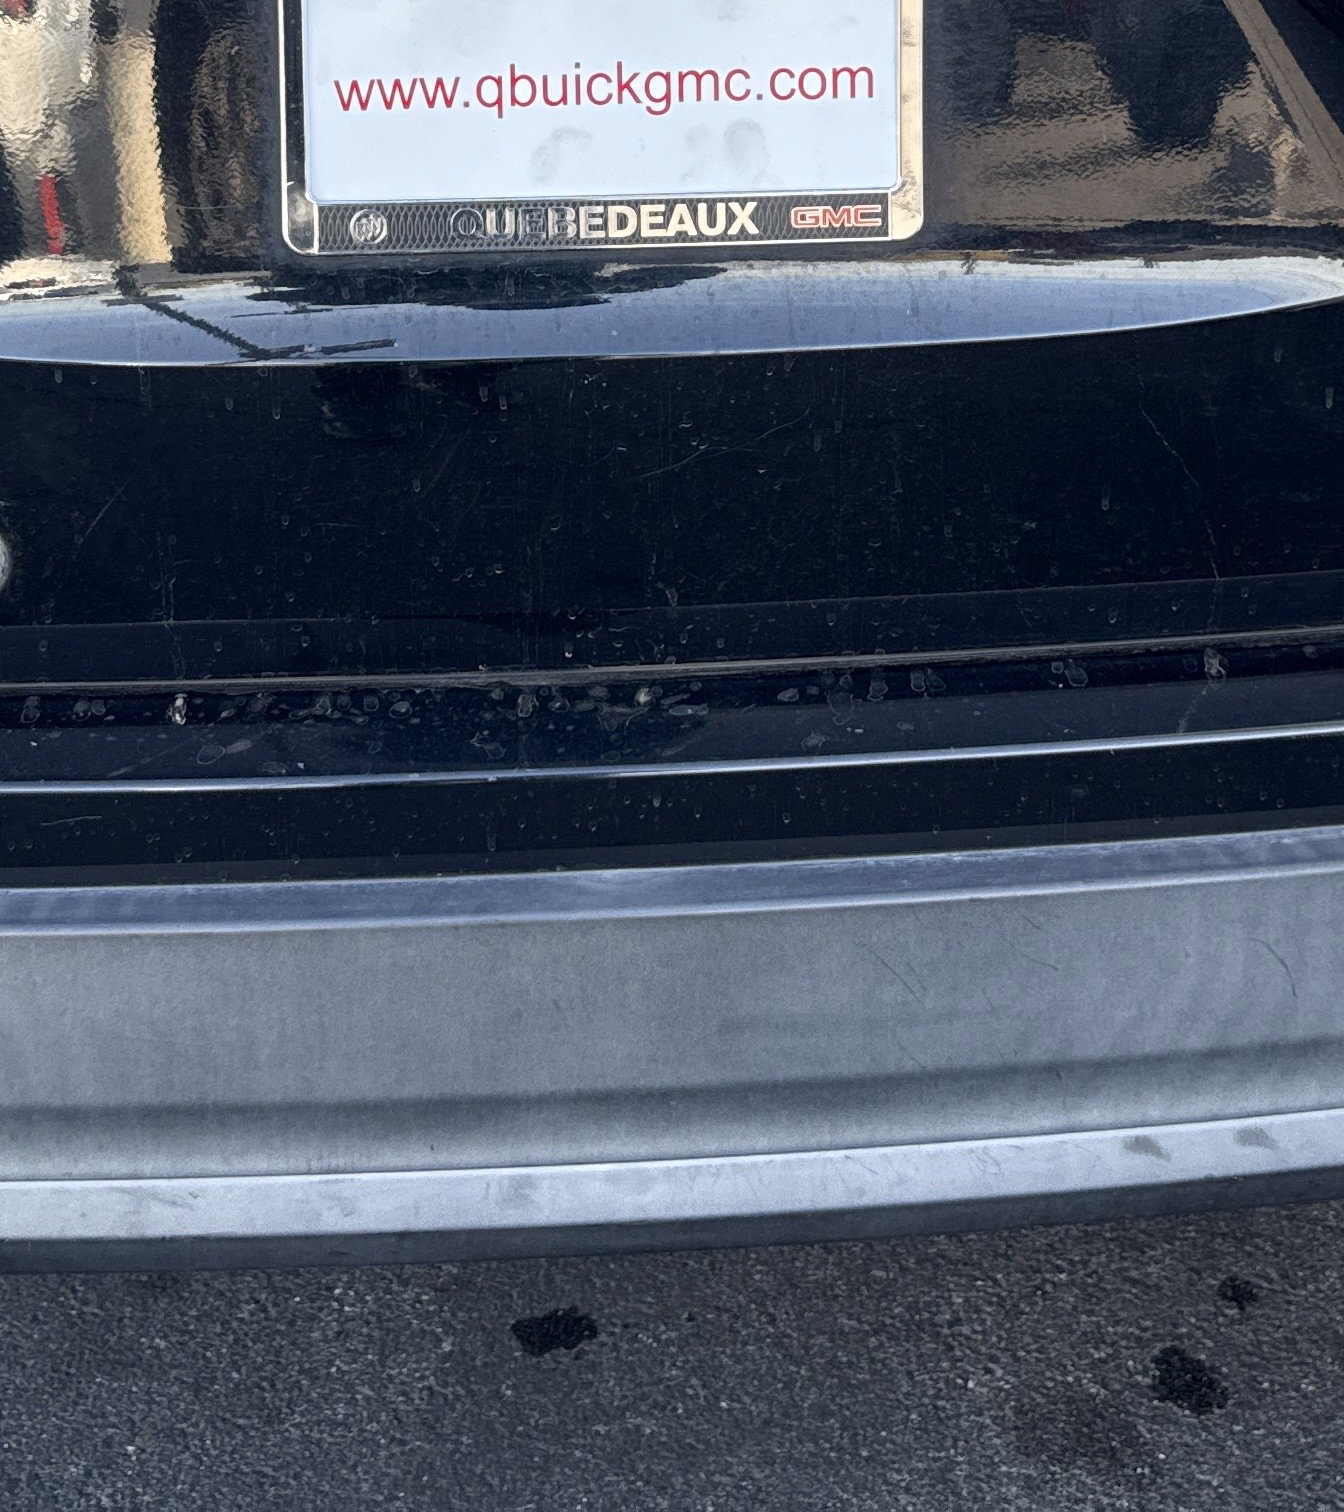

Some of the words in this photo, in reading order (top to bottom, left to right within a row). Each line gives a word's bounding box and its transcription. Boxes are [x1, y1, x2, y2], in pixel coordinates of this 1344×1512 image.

[334, 62, 875, 119] www.qbuickgmc.com
[450, 201, 760, 239] QUEBEDEAUX
[790, 204, 882, 230] GMC
